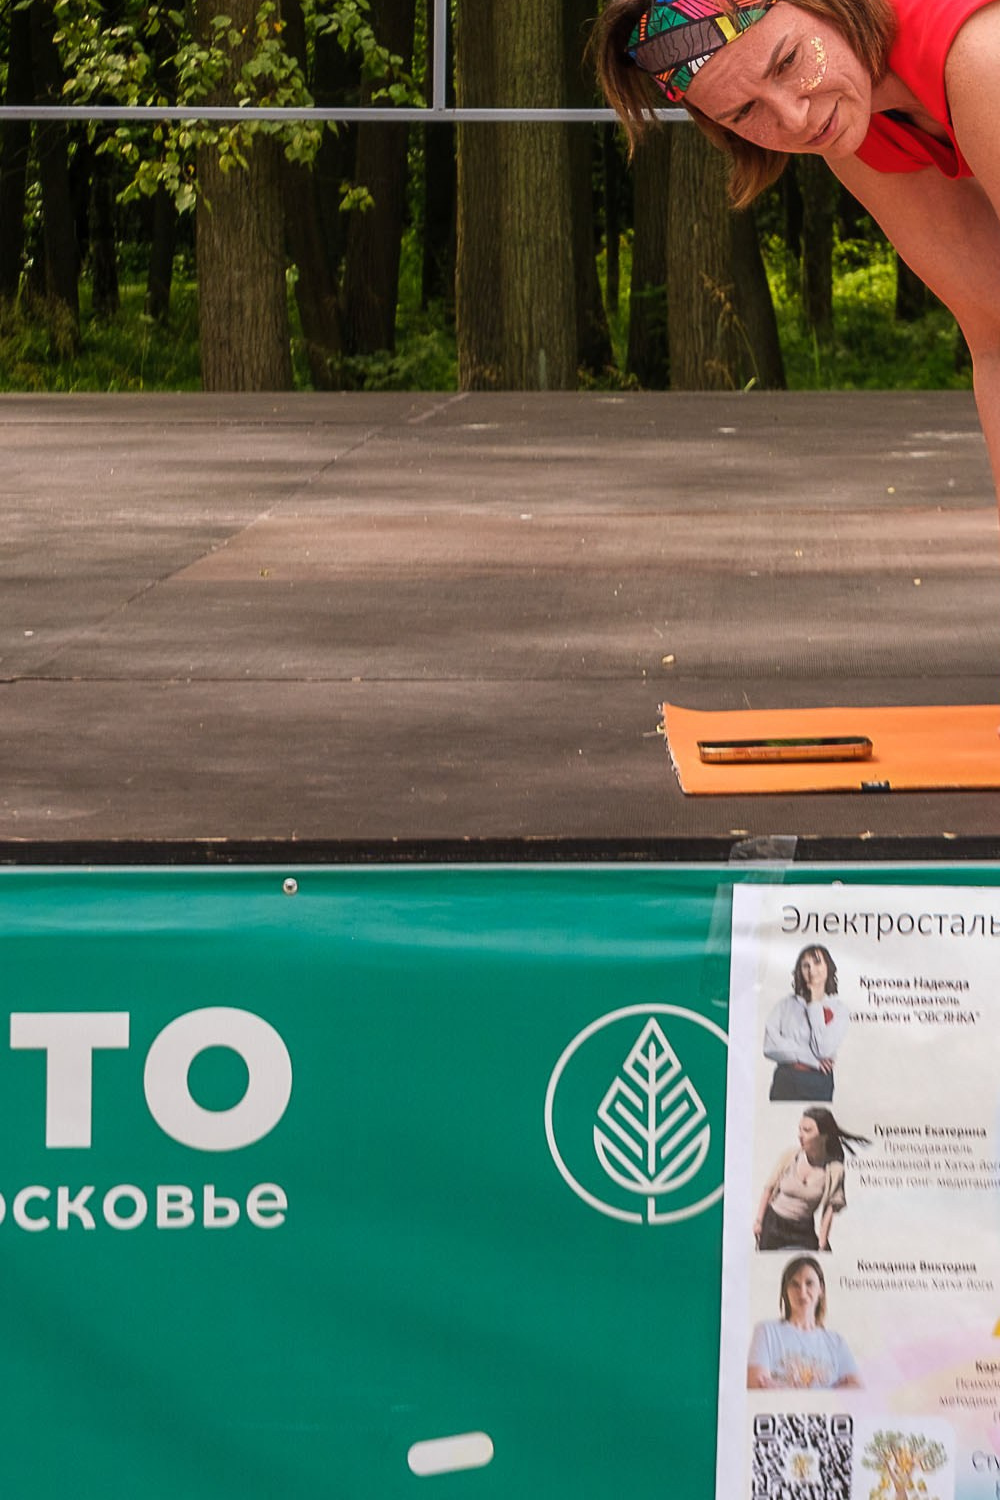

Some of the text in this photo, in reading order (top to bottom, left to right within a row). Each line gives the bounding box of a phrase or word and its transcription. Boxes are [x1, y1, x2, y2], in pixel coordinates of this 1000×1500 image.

[914, 977, 970, 992] Надежда
[868, 992, 961, 1007] Преподаватель
[873, 1124, 988, 1140] Гуревич Екатерина
[884, 1140, 973, 1156] Преподаватель
[859, 1174, 903, 1189] Мастер
[0, 1182, 288, 1232] сковье
[919, 1260, 978, 1275] Виктория
[839, 1276, 928, 1291] Преподаватель
